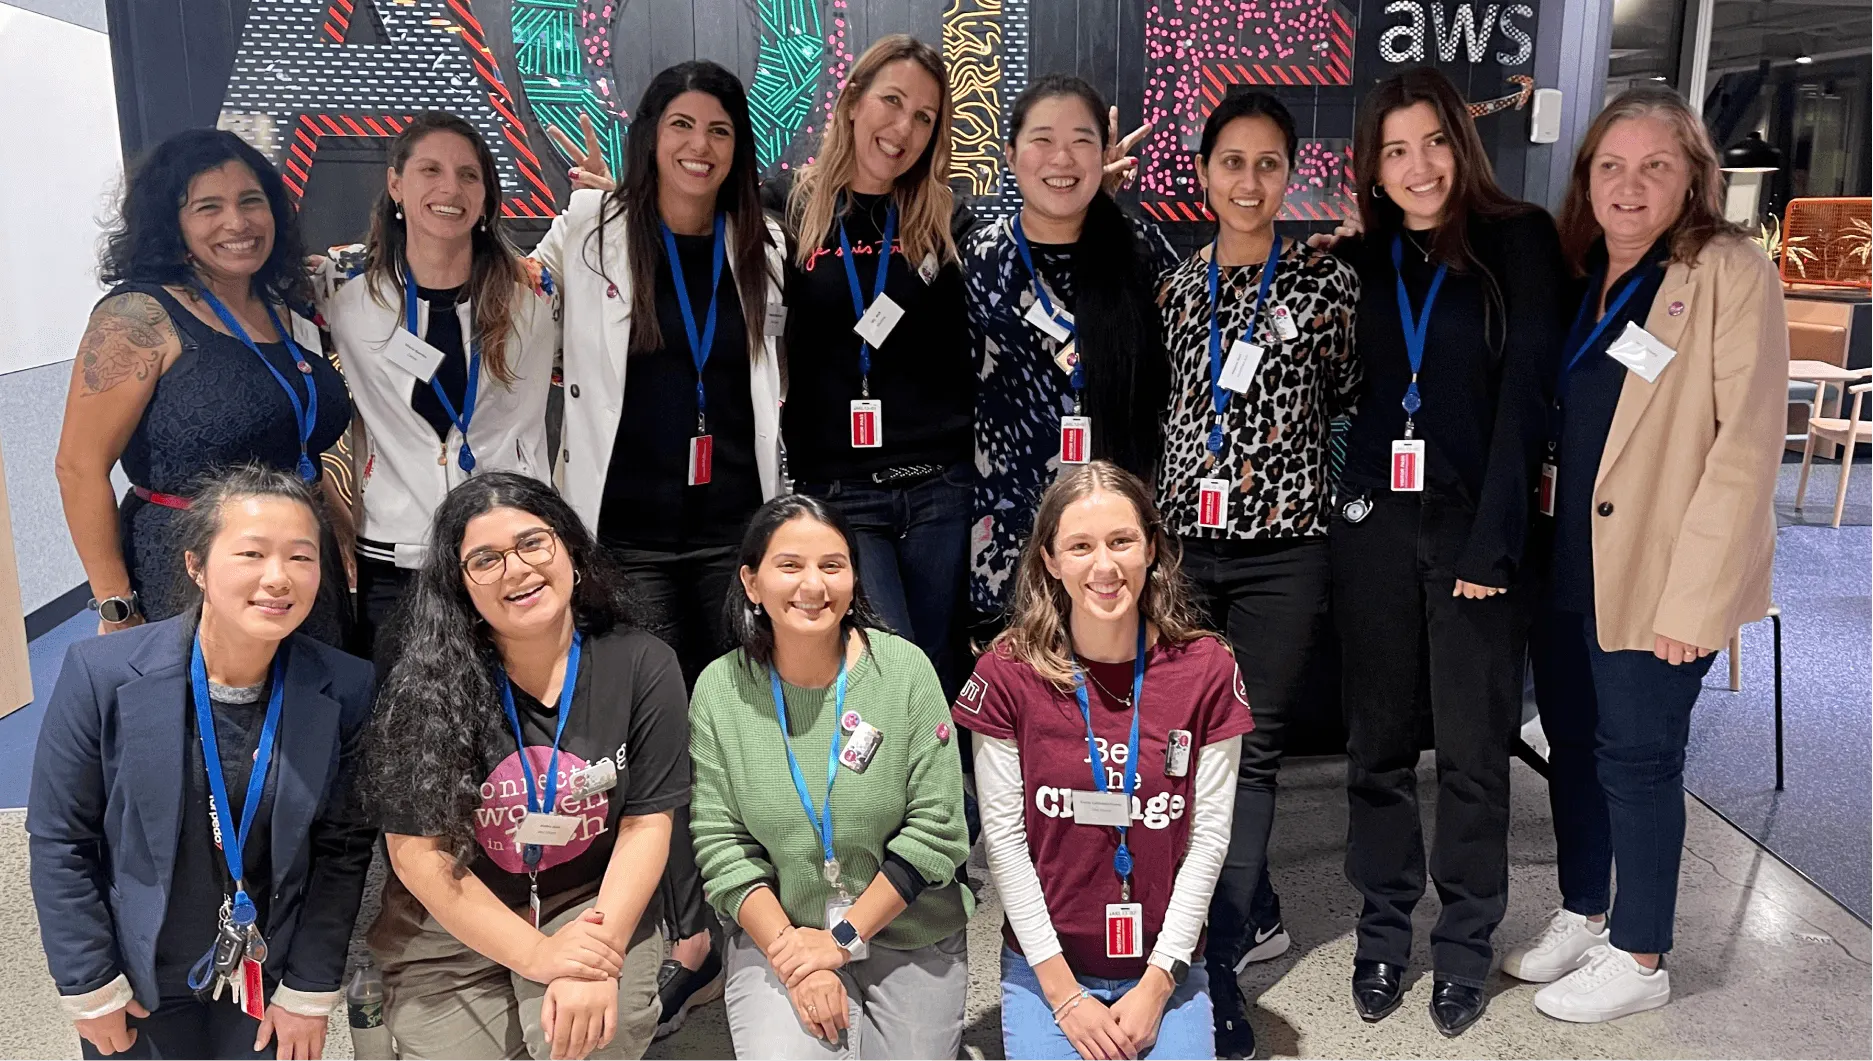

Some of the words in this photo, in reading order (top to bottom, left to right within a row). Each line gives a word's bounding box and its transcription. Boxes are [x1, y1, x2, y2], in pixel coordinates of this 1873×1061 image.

[1379, 0, 1533, 66] aws
[1083, 737, 1130, 764] Be
[1104, 767, 1142, 790] he
[473, 791, 609, 829] woen
[487, 837, 505, 852] in
